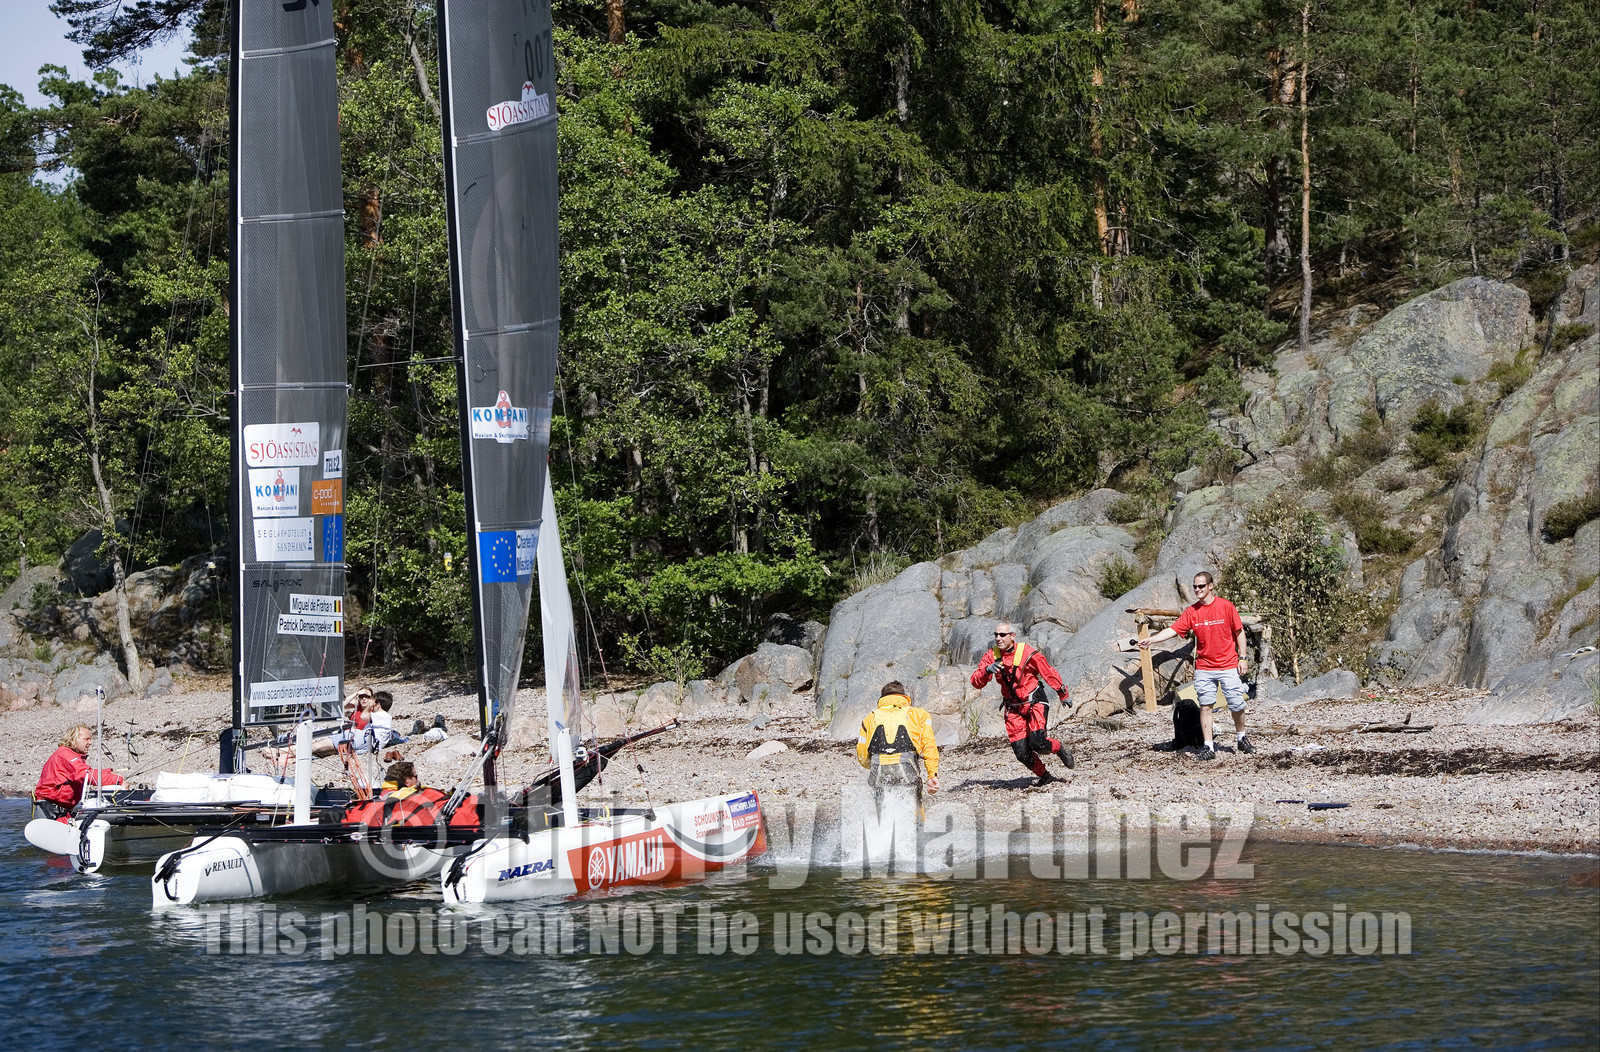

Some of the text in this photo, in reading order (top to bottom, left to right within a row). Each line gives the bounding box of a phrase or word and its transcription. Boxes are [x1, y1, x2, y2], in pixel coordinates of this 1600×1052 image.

[487, 95, 549, 129] SJÖASSISTANS
[473, 408, 527, 422] KOMPANI
[250, 440, 318, 462] SJÖASSISTANS
[255, 484, 298, 497] KOMPANI
[292, 597, 309, 613] Miguel
[279, 618, 298, 631] Patrick
[212, 857, 243, 872] RENAULT
[606, 834, 665, 884] YAMAHA
